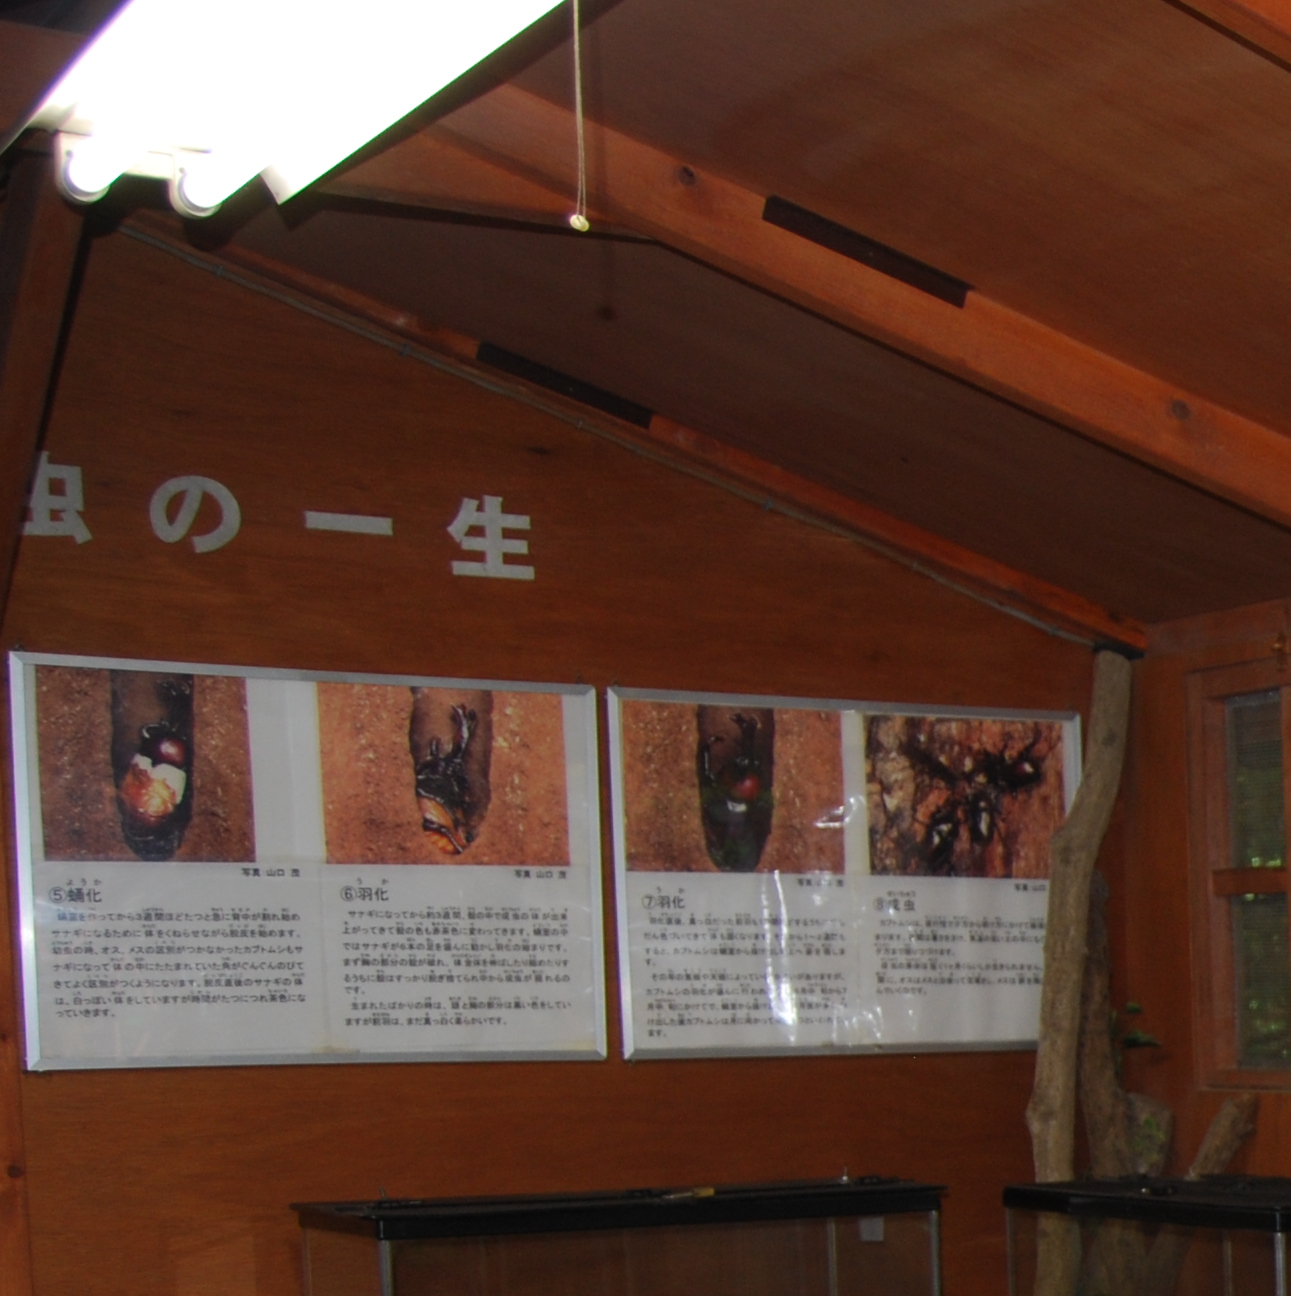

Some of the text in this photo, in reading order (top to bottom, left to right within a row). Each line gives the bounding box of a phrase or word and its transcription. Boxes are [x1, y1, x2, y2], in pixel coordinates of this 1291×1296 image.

[242, 868, 260, 877] 写真
[266, 868, 285, 877] 山口
[515, 870, 531, 878] 写真
[536, 870, 553, 878] 山口
[344, 986, 366, 995] です。
